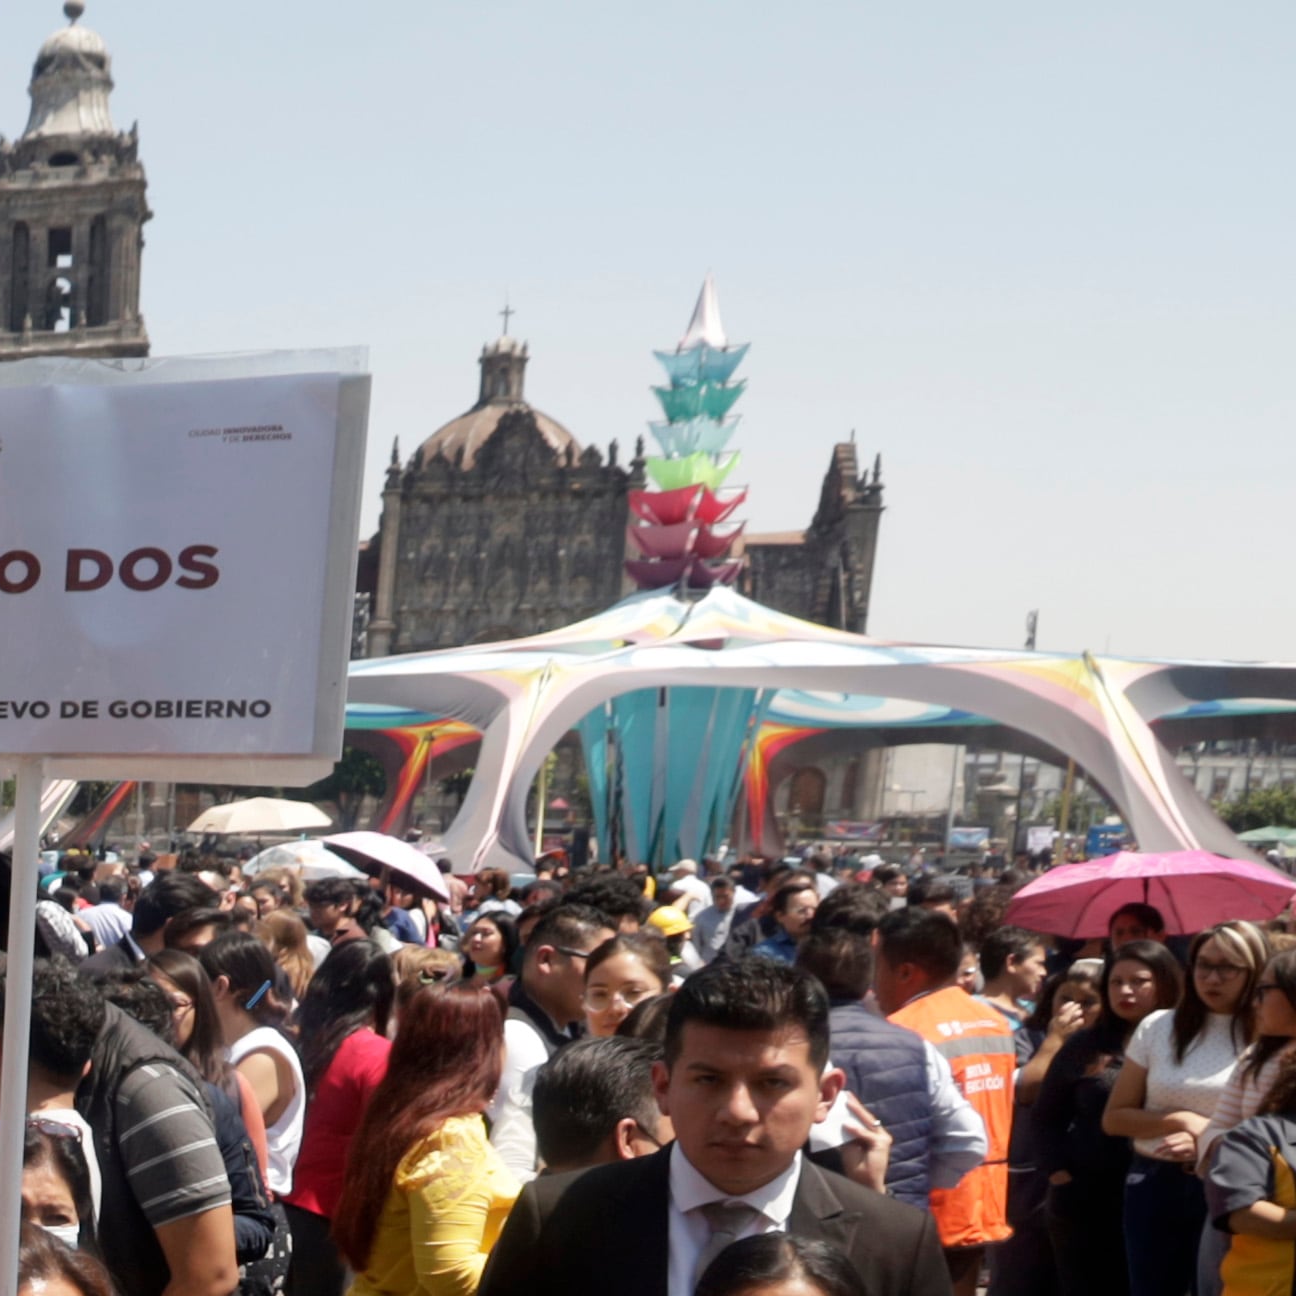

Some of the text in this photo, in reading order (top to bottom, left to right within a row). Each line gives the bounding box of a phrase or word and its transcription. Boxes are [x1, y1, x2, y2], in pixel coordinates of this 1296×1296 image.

[64, 544, 220, 593] DOS
[60, 700, 99, 719] DE
[108, 699, 272, 720] GOBIERNO
